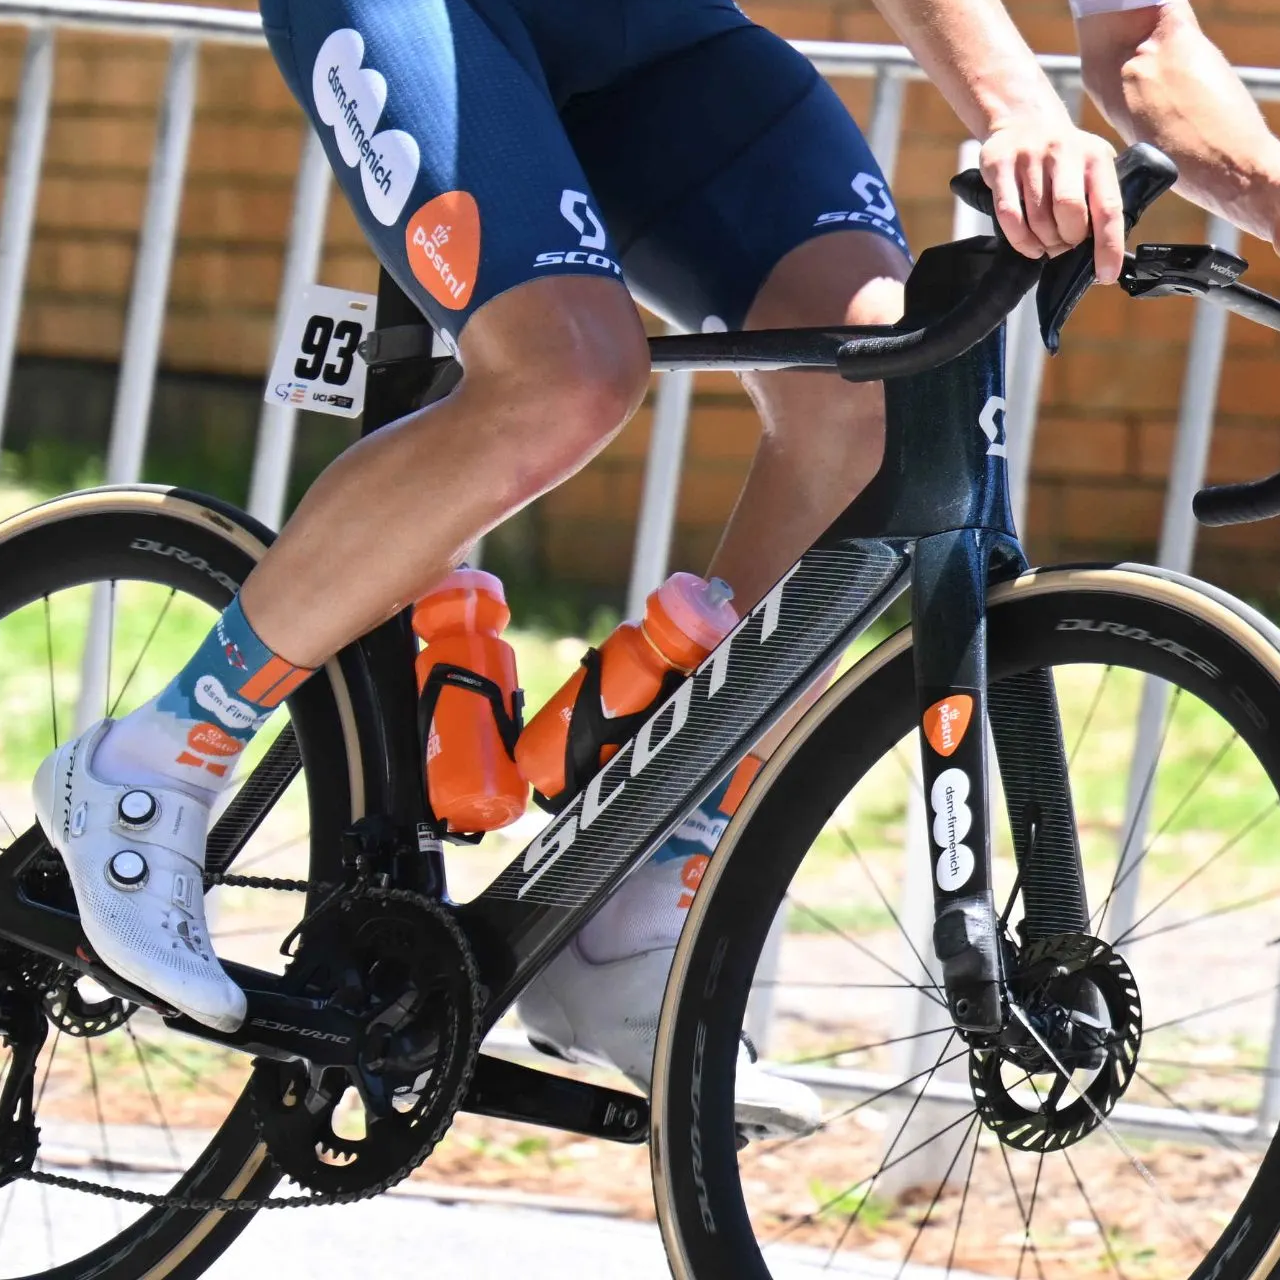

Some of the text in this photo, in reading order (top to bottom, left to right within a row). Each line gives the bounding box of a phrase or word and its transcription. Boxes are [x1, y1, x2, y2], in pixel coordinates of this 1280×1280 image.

[327, 65, 393, 196] dsm-firmenich
[412, 225, 467, 300] postnl
[294, 314, 363, 386] 93
[517, 559, 802, 899] SCOTT
[937, 703, 955, 749] postnl
[945, 785, 961, 877] dsm-firmenich
